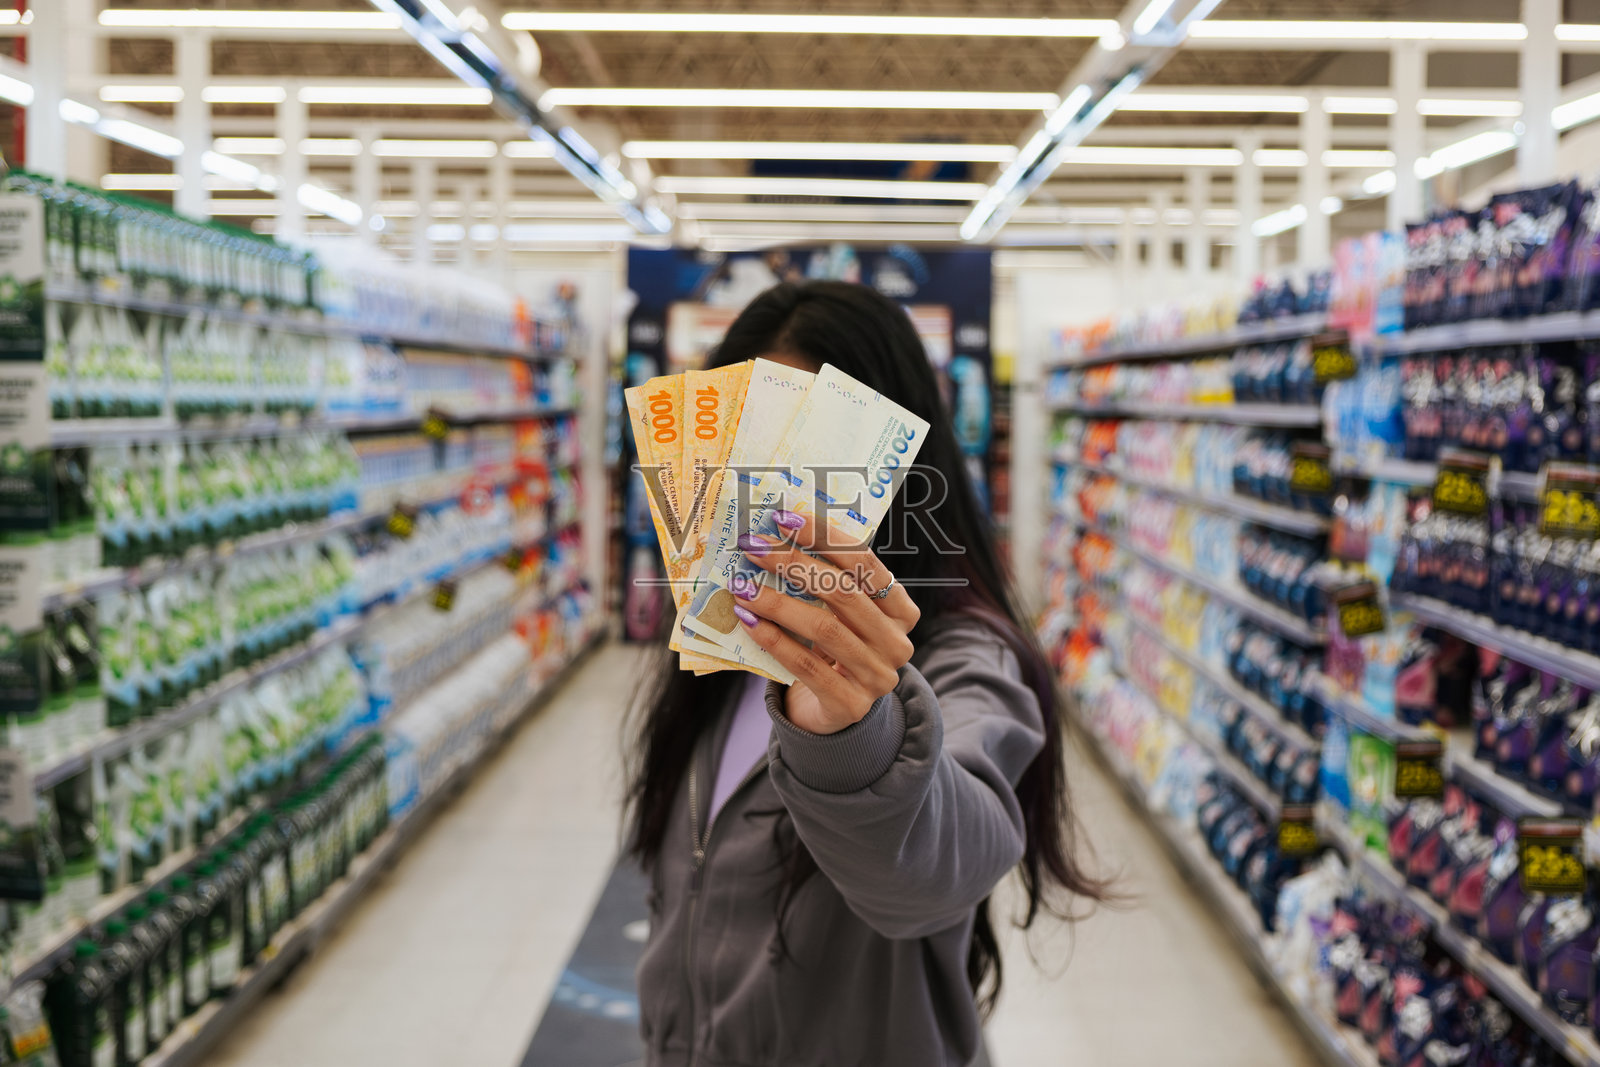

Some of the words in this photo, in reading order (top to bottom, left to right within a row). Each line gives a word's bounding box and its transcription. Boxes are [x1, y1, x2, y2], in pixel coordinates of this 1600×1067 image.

[648, 390, 677, 443] 1000
[695, 385, 719, 440] 1000
[666, 461, 675, 484] BANCO
[669, 486, 680, 514] CENTRAL
[721, 498, 739, 534] VEINTE
[751, 492, 776, 526] VEINTE
[665, 500, 676, 537] ARGENTINA
[716, 536, 728, 555] MIL
